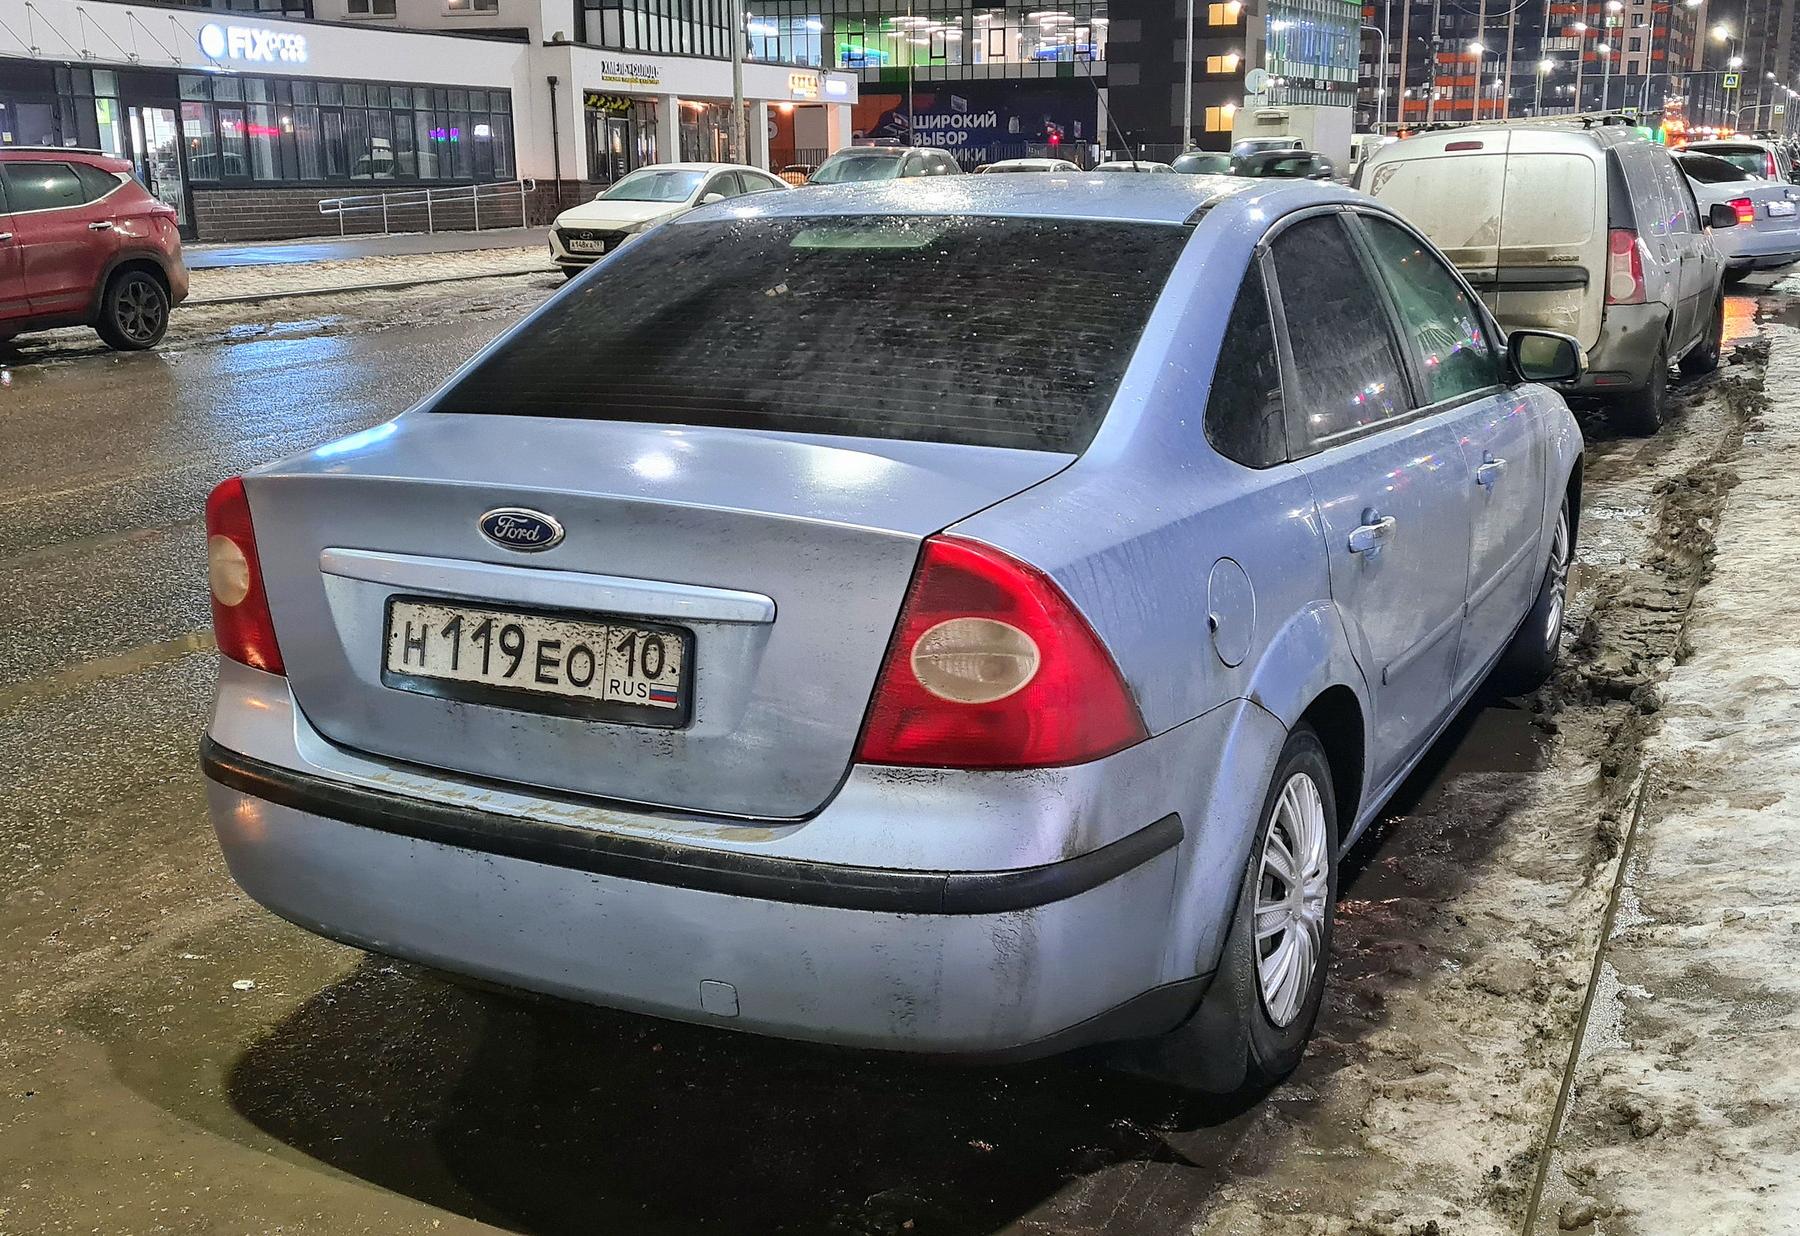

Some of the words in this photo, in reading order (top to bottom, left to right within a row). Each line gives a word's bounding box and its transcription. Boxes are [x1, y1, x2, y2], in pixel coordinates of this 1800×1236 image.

[227, 26, 273, 61] FIX
[913, 110, 997, 129] ШИРОКИЙ
[913, 131, 968, 146] ВЫБОР
[494, 515, 540, 541] Ford
[617, 631, 666, 680] 10
[609, 679, 648, 699] RUS
